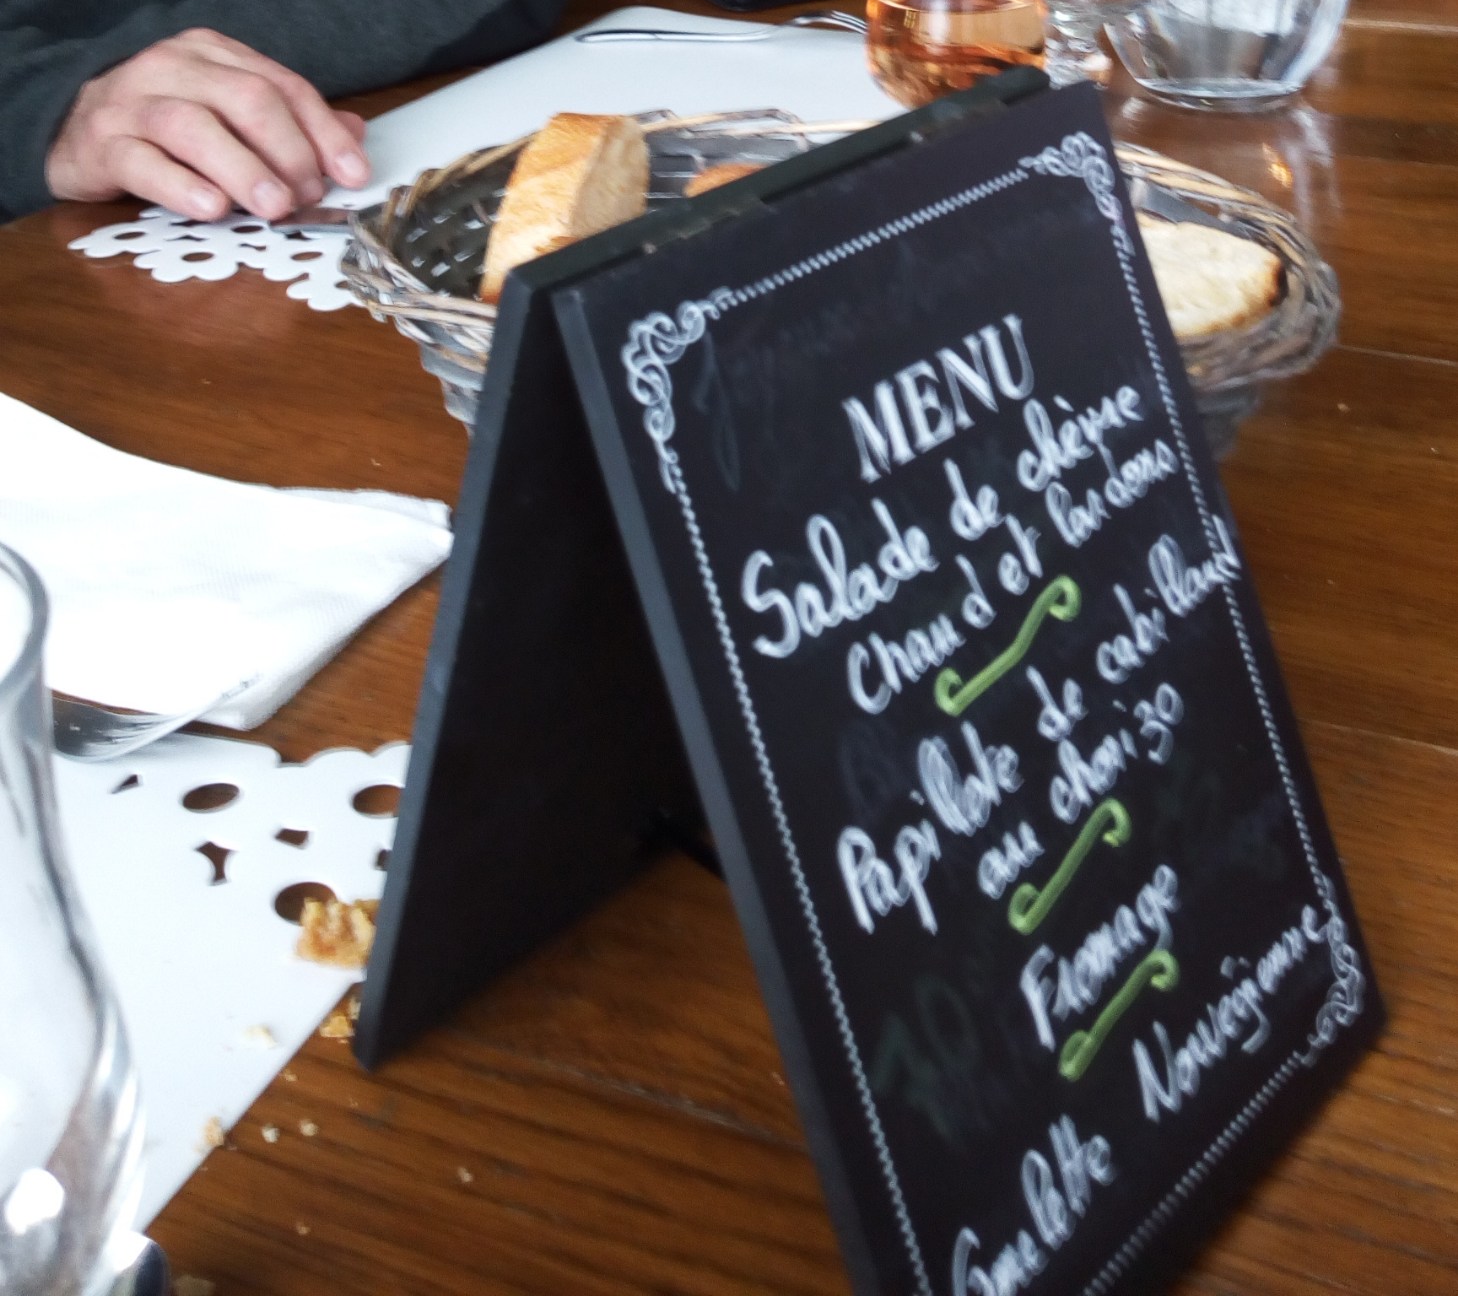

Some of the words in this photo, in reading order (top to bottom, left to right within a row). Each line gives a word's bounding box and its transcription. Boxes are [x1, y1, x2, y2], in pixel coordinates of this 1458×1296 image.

[842, 314, 1033, 482] MENU
[741, 500, 940, 659] Salade
[945, 459, 999, 541] de
[847, 556, 997, 714] Chaud
[999, 512, 1043, 596] et
[1027, 664, 1088, 742] de
[977, 820, 1045, 900] au
[1020, 864, 1180, 1051] Fromage
